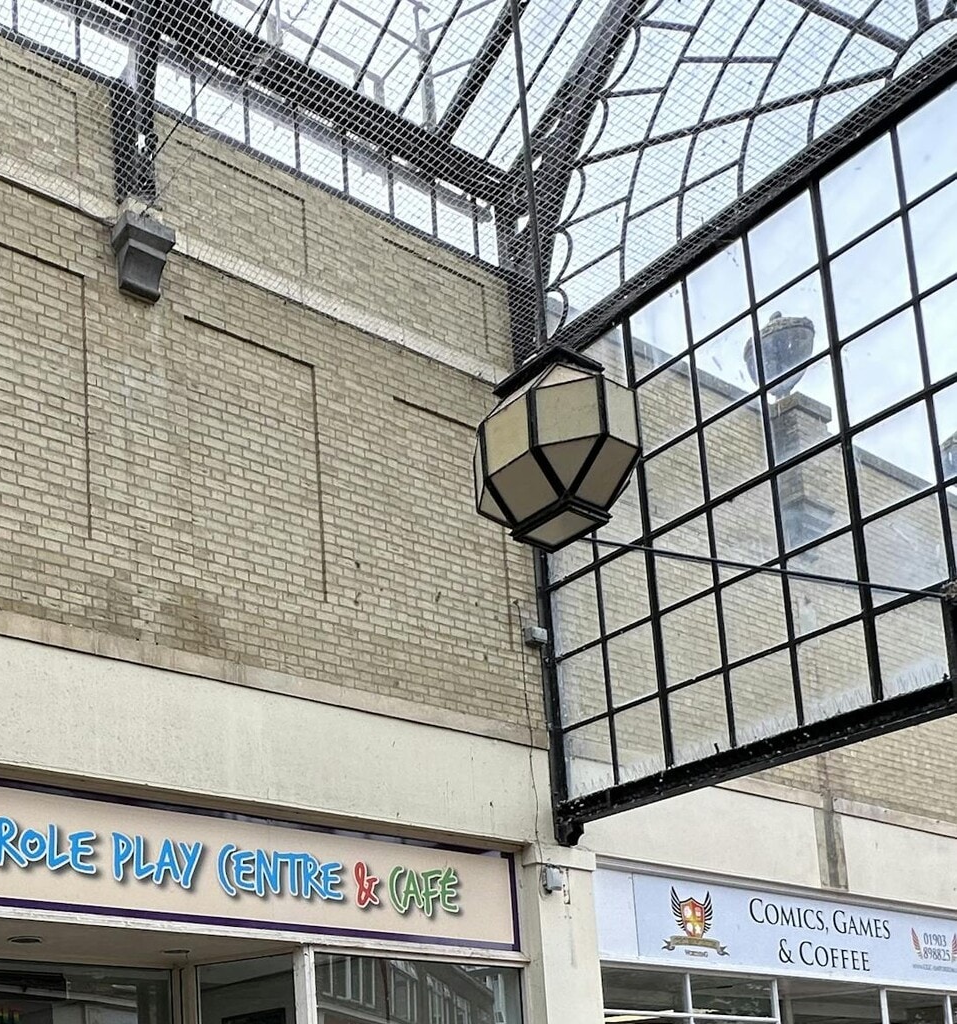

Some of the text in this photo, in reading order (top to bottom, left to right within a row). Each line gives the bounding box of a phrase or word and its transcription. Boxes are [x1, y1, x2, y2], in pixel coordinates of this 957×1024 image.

[111, 831, 203, 889] PLAY
[217, 843, 344, 901] CENTRE
[353, 861, 380, 908] &
[832, 909, 891, 940] GAMES
[923, 932, 947, 948] 01903
[778, 938, 871, 972] & COFFEE
[923, 946, 951, 962] 898825
